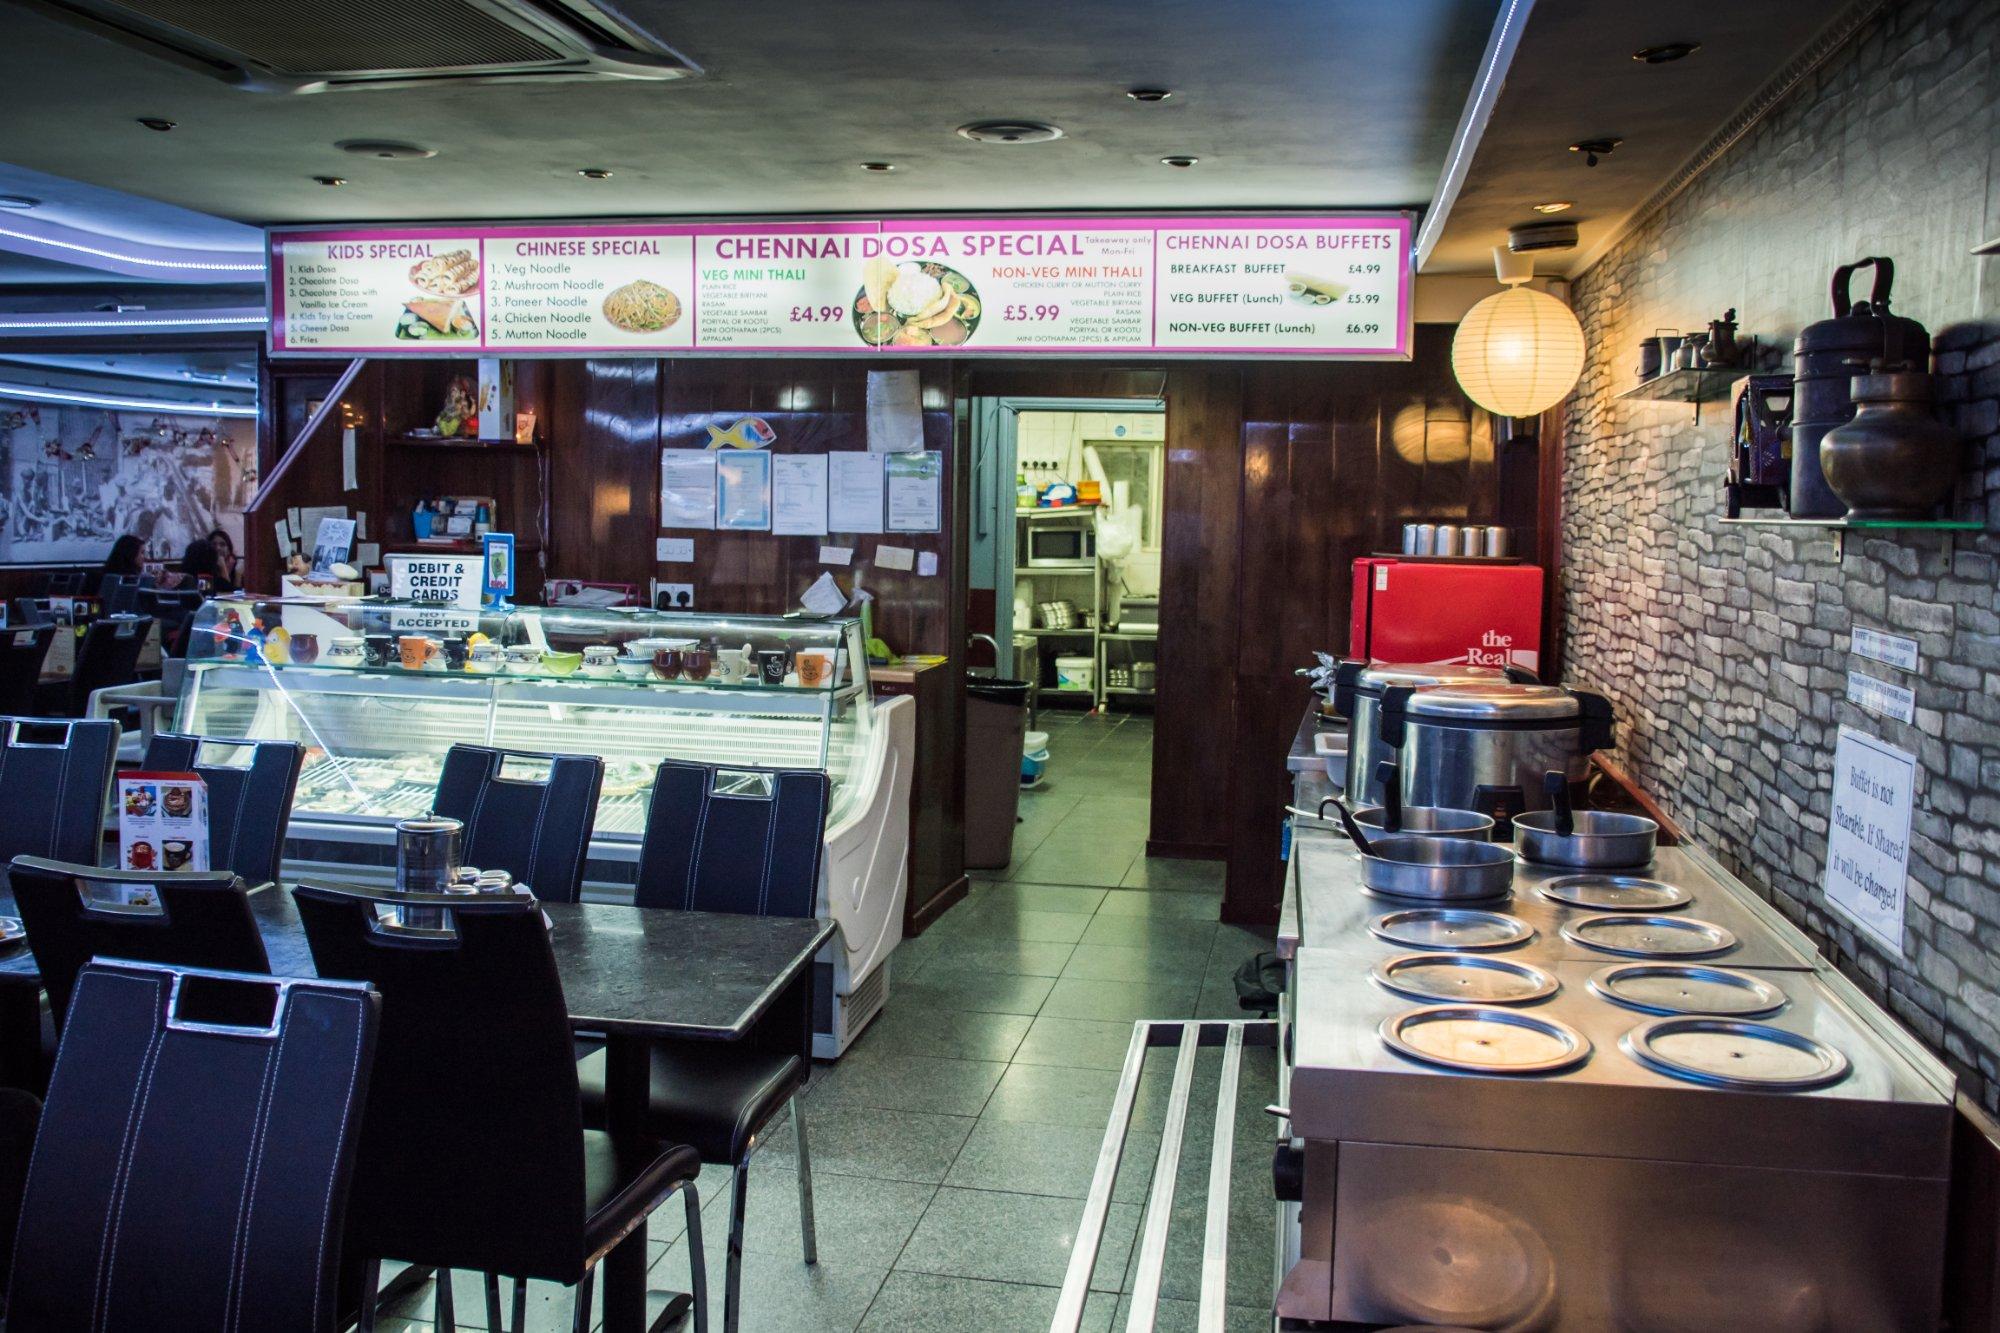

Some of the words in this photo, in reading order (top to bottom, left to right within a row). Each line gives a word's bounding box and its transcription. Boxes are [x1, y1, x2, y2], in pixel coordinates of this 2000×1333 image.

[1086, 236, 1129, 244] Takeaway
[1133, 236, 1152, 244] only
[1166, 236, 1249, 250] CHENNAI
[1256, 236, 1308, 249] DOSA
[1316, 235, 1391, 249] BUFFETS
[328, 245, 364, 259] KIDS
[370, 244, 433, 258] SPECIAL
[516, 242, 585, 256] CHINESE
[592, 241, 660, 255] SPECIAL
[716, 237, 850, 259] CHENNAI
[863, 236, 949, 258] DOSA
[962, 235, 1084, 256] SPECIAL
[1101, 247, 1135, 255] Mon-Fri
[491, 264, 500, 274] 1.
[504, 264, 526, 276] Veg
[530, 263, 571, 274] Noodle
[992, 267, 1060, 277] NON-VEG
[1065, 267, 1097, 277] MINI
[1102, 267, 1142, 277] THALI
[1170, 264, 1236, 274] BREAKFAST
[1245, 264, 1285, 274] BUFFET
[1348, 264, 1380, 274] £4.99
[702, 270, 729, 280] VEG
[734, 270, 763, 280] MINI
[768, 270, 805, 280] THALI
[340, 277, 359, 285] Dosa
[491, 281, 500, 291] 2.
[504, 280, 559, 290] Mushroom
[563, 279, 604, 290] Noodle
[299, 289, 337, 297] Chocolate
[491, 297, 501, 307] 3.
[505, 297, 542, 307] Paneer
[547, 296, 588, 306] Noodle
[1170, 294, 1193, 303] VEG
[1198, 294, 1238, 303] BUFFET
[1242, 293, 1283, 305] (Lunch)
[1347, 295, 1379, 304] £5.99
[318, 313, 330, 321] Toy
[491, 313, 501, 323] 4.
[505, 312, 546, 323] Chicken
[550, 312, 591, 322] Noodle
[790, 307, 844, 322] £4.99
[1003, 305, 1059, 321] £5.99
[330, 324, 349, 332] Dosa
[1169, 323, 1225, 333] NON-VEG
[1230, 323, 1271, 333] BUFFET
[1274, 323, 1316, 334] (Lunch)
[1346, 324, 1378, 334] £6.99
[491, 330, 501, 340] 5.
[505, 330, 542, 339] Mutton
[546, 329, 587, 339] Noodle
[1078, 335, 1101, 343] (2PCS)
[409, 564, 450, 574] DEBIT
[455, 564, 464, 574] &
[410, 576, 462, 586] CREDIT
[412, 590, 458, 600] CARDS
[397, 619, 470, 628] ACCEPTED
[1482, 630, 1512, 647] the
[1467, 648, 1512, 665] Real
[1850, 766, 1870, 795] Buffet
[1872, 775, 1878, 798] is
[1880, 786, 1893, 806] not
[1867, 823, 1873, 845] If
[1875, 828, 1904, 863] Shared
[1834, 850, 1840, 870] it
[1841, 856, 1853, 880] will
[1854, 867, 1862, 888] be
[1864, 872, 1897, 910] charged
